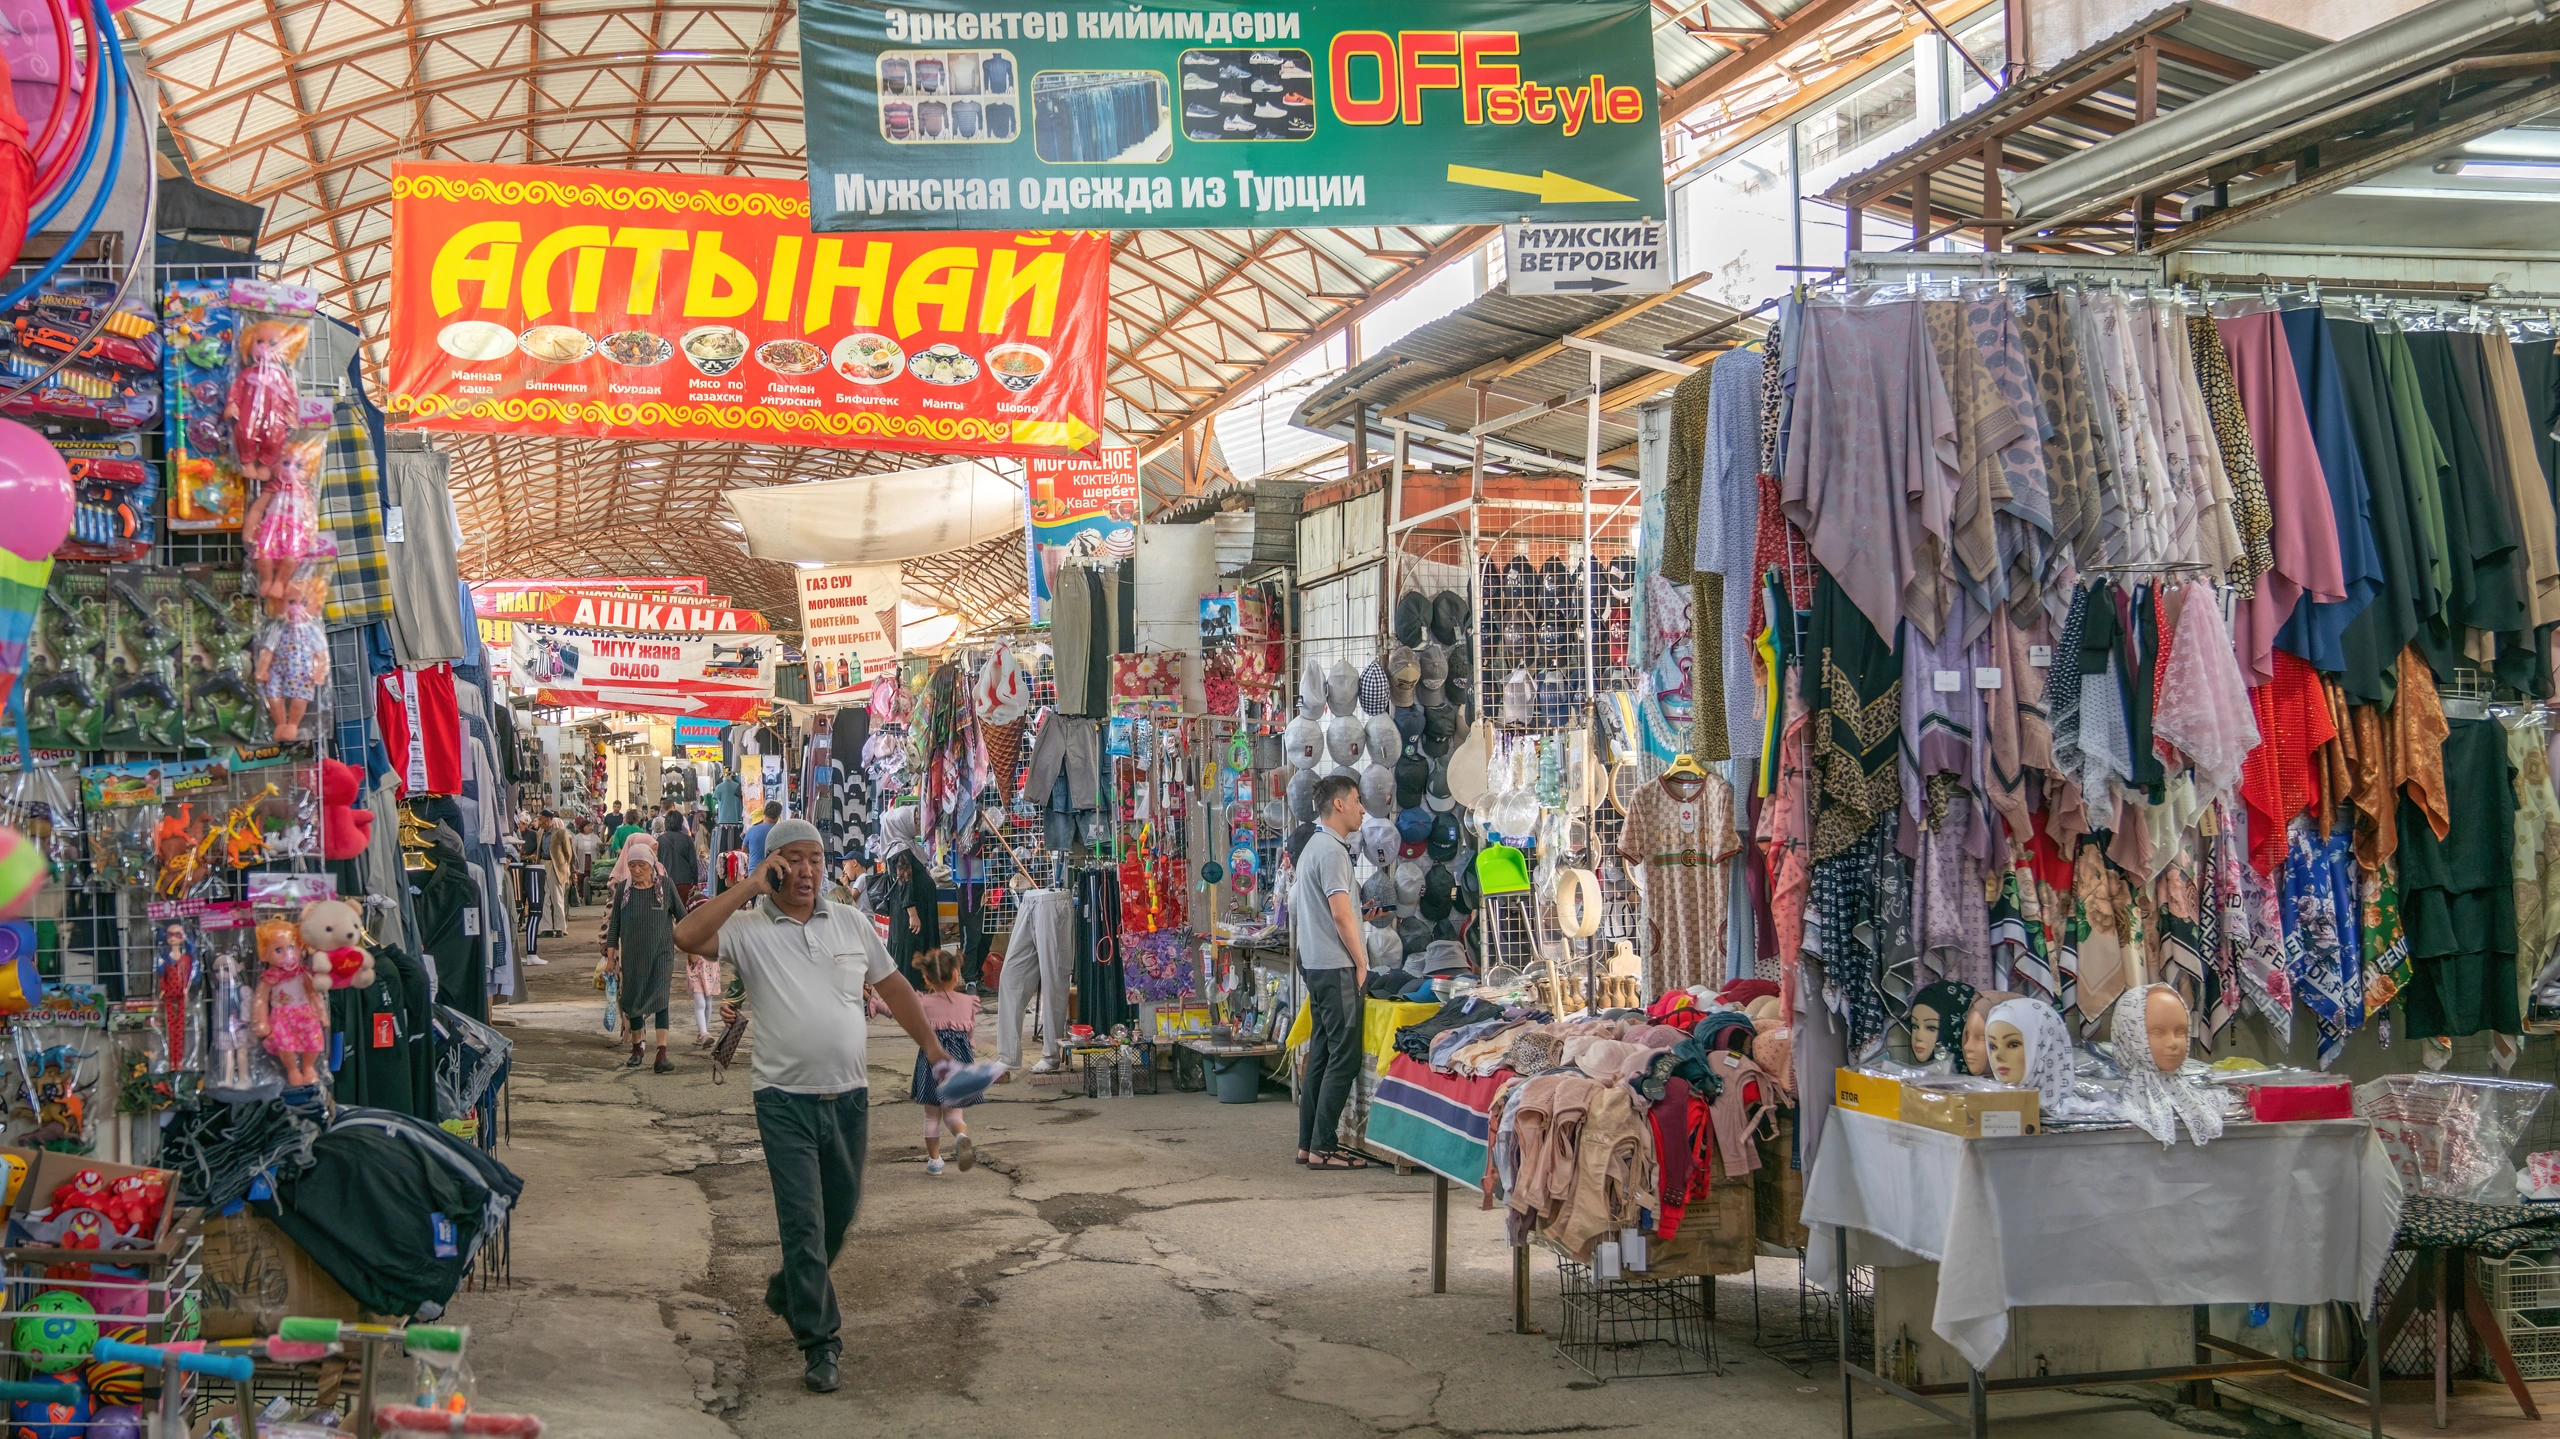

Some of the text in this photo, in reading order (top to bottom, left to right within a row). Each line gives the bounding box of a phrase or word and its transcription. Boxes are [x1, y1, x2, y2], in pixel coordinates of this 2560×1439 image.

[884, 4, 1301, 43] Эркектер кийимдери
[1329, 30, 1520, 125] OFF
[1487, 75, 1643, 136] style
[834, 170, 1365, 215] Мужская одежда из Турции
[1518, 227, 1660, 249] МУЖСКИЕ
[1519, 251, 1657, 272] ВЕТРОВКИ
[431, 221, 1066, 340] АЛТЫНАЙ
[451, 370, 502, 382] Манная
[459, 384, 493, 394] каша
[525, 380, 588, 393] Блинчики
[609, 383, 662, 395] Куурдак
[689, 378, 743, 389] Мясо по
[768, 382, 815, 394] Лагман
[689, 392, 743, 402] казахски
[760, 395, 822, 407] уйгурский
[835, 393, 899, 406] Бифштекс
[922, 398, 964, 410] Манты
[1073, 471, 1135, 485] КОКТЕЙЛЬ
[1083, 485, 1136, 499] шербет
[1066, 497, 1098, 509] Квас
[806, 575, 852, 592] ГАЗ СУУ
[808, 595, 868, 611] МОРОЖЕНОЕ
[572, 598, 737, 631] АШКАНА
[810, 614, 859, 629] КОКТЕЙЛЬ
[838, 631, 881, 645] ШЕРБЕТИ
[639, 645, 680, 660] жана
[864, 661, 897, 674] НАПИТКИ
[174, 777, 212, 790] WORLD
[12, 1009, 101, 1022] DINO WORLD
